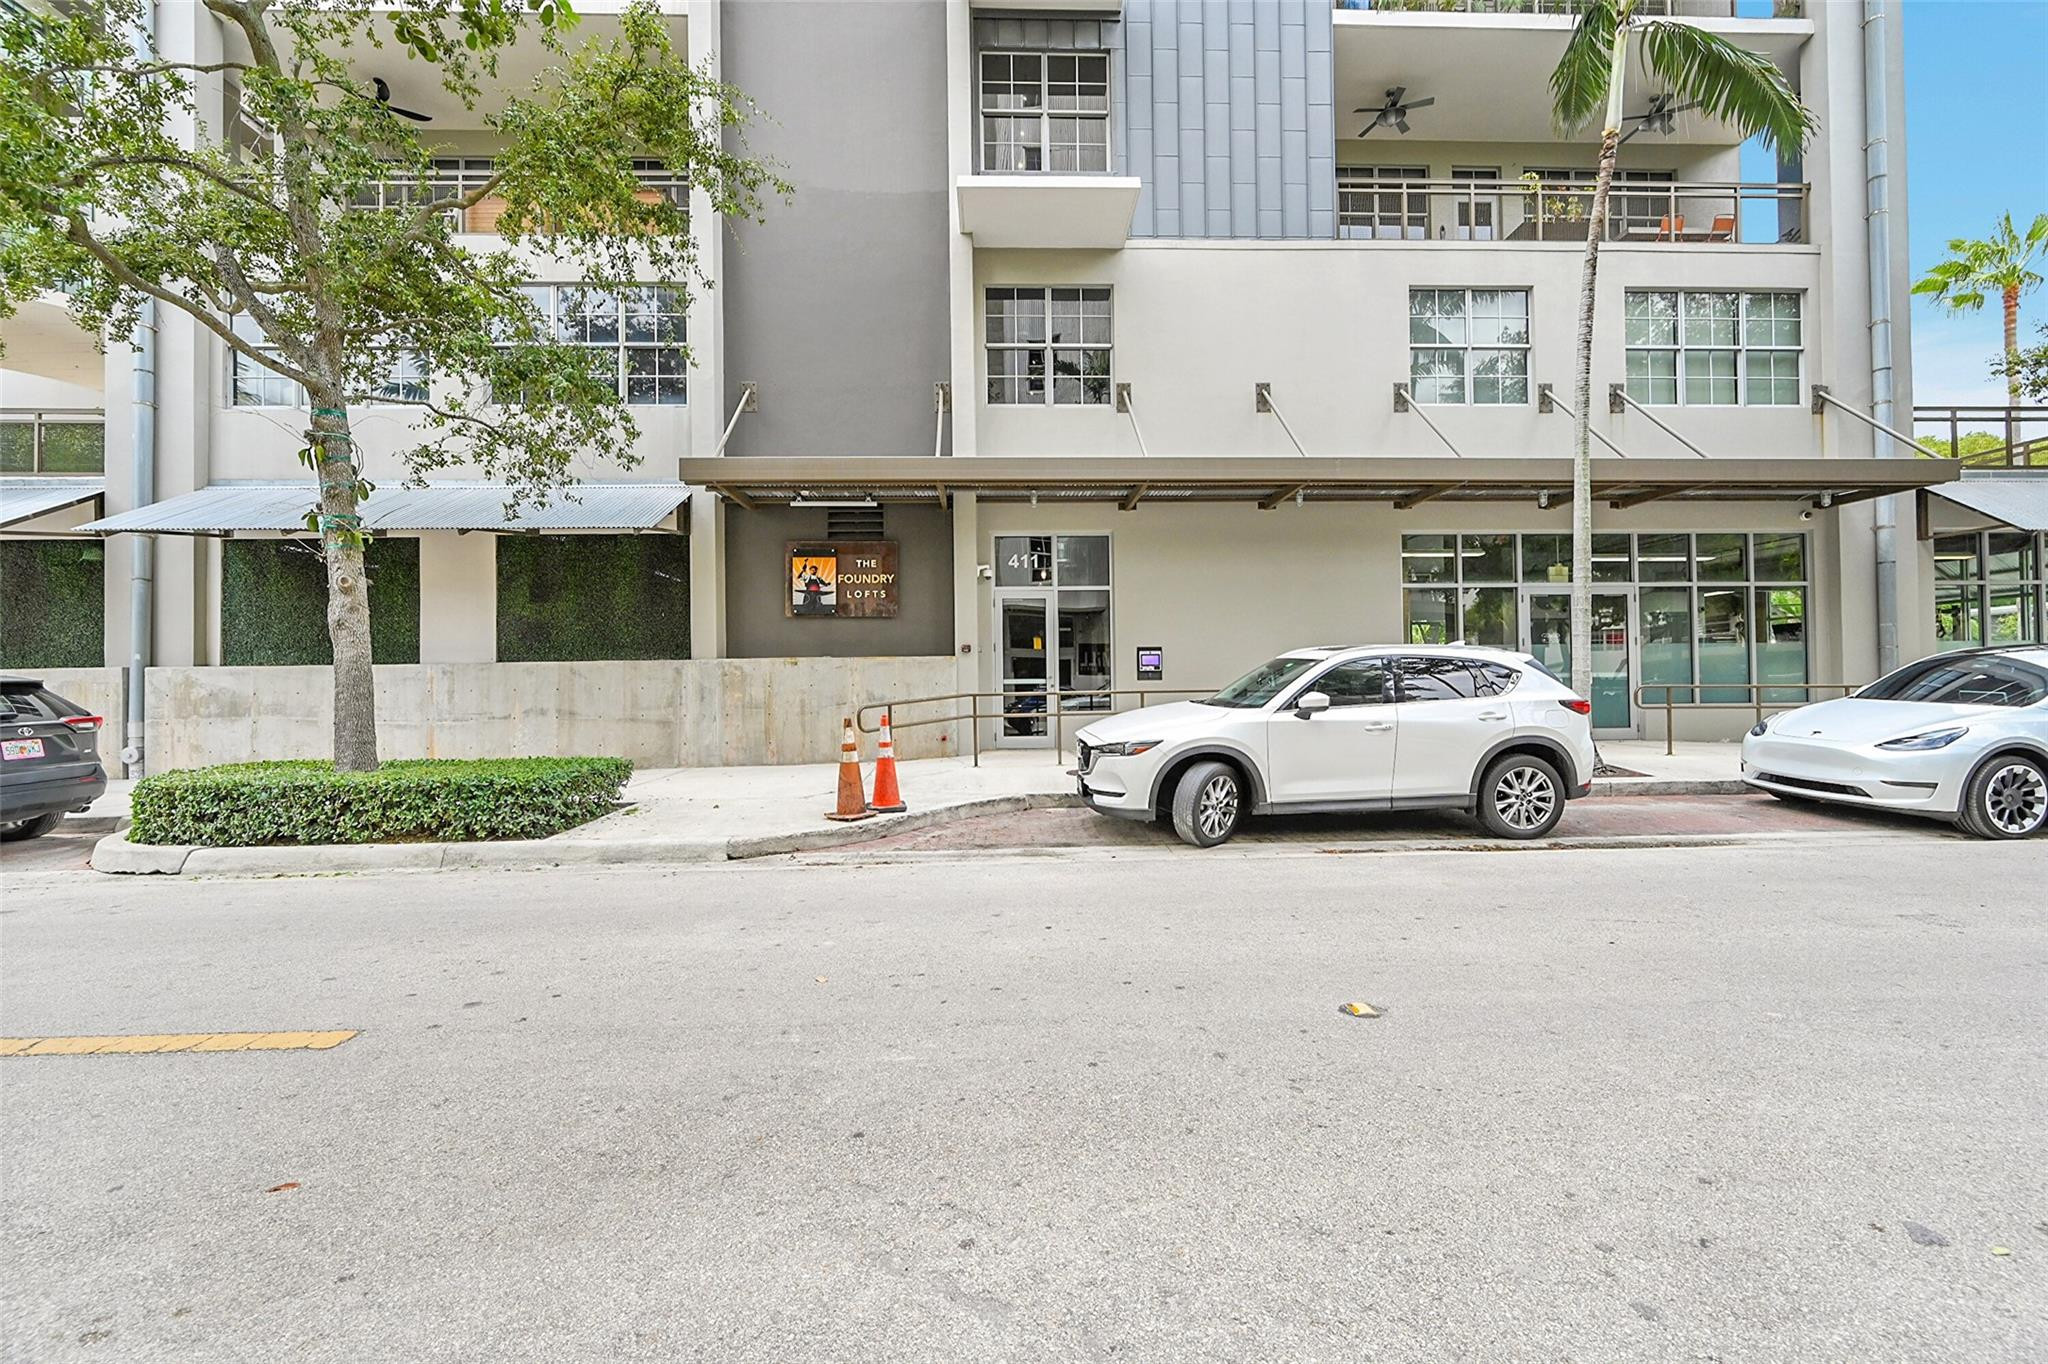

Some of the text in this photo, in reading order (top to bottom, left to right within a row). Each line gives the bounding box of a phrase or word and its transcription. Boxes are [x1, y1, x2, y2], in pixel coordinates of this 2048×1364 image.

[856, 560, 877, 568] THE
[1008, 554, 1038, 568] 411
[838, 574, 895, 584] FOUNDRY
[846, 590, 886, 598] LOFTS
